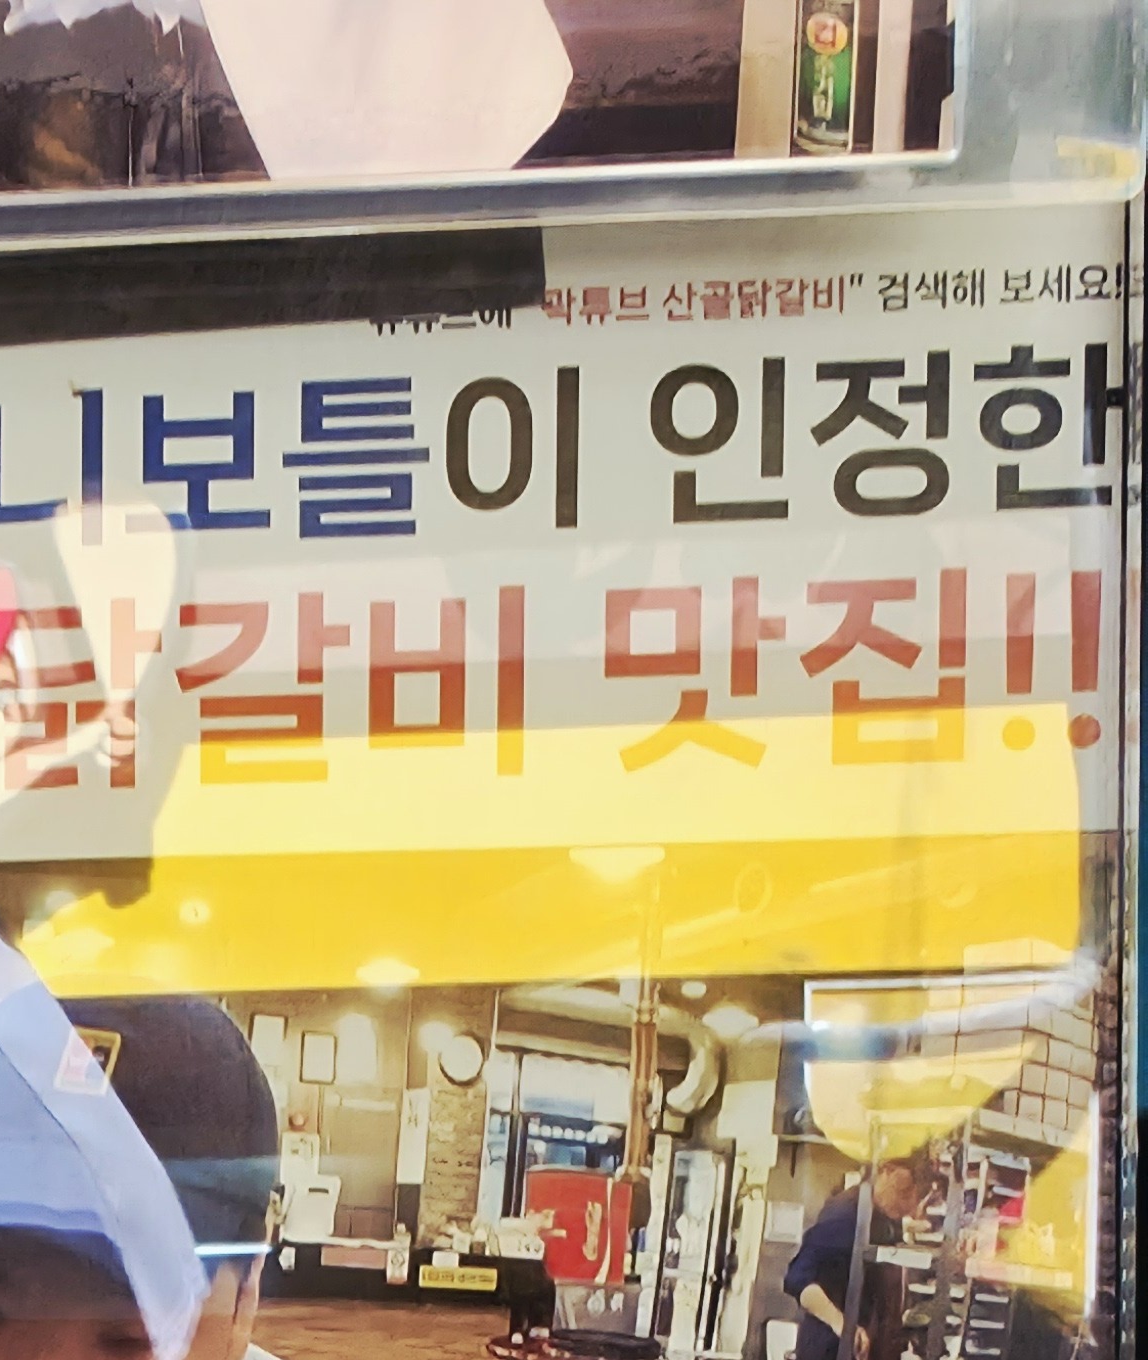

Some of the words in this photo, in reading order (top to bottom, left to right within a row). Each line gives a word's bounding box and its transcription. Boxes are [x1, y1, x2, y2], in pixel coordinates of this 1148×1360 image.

[877, 267, 985, 311] 검색해
[1000, 261, 1123, 305] 보세요!
[650, 341, 1124, 526] 인정한
[602, 566, 1103, 774] 맛집!!
